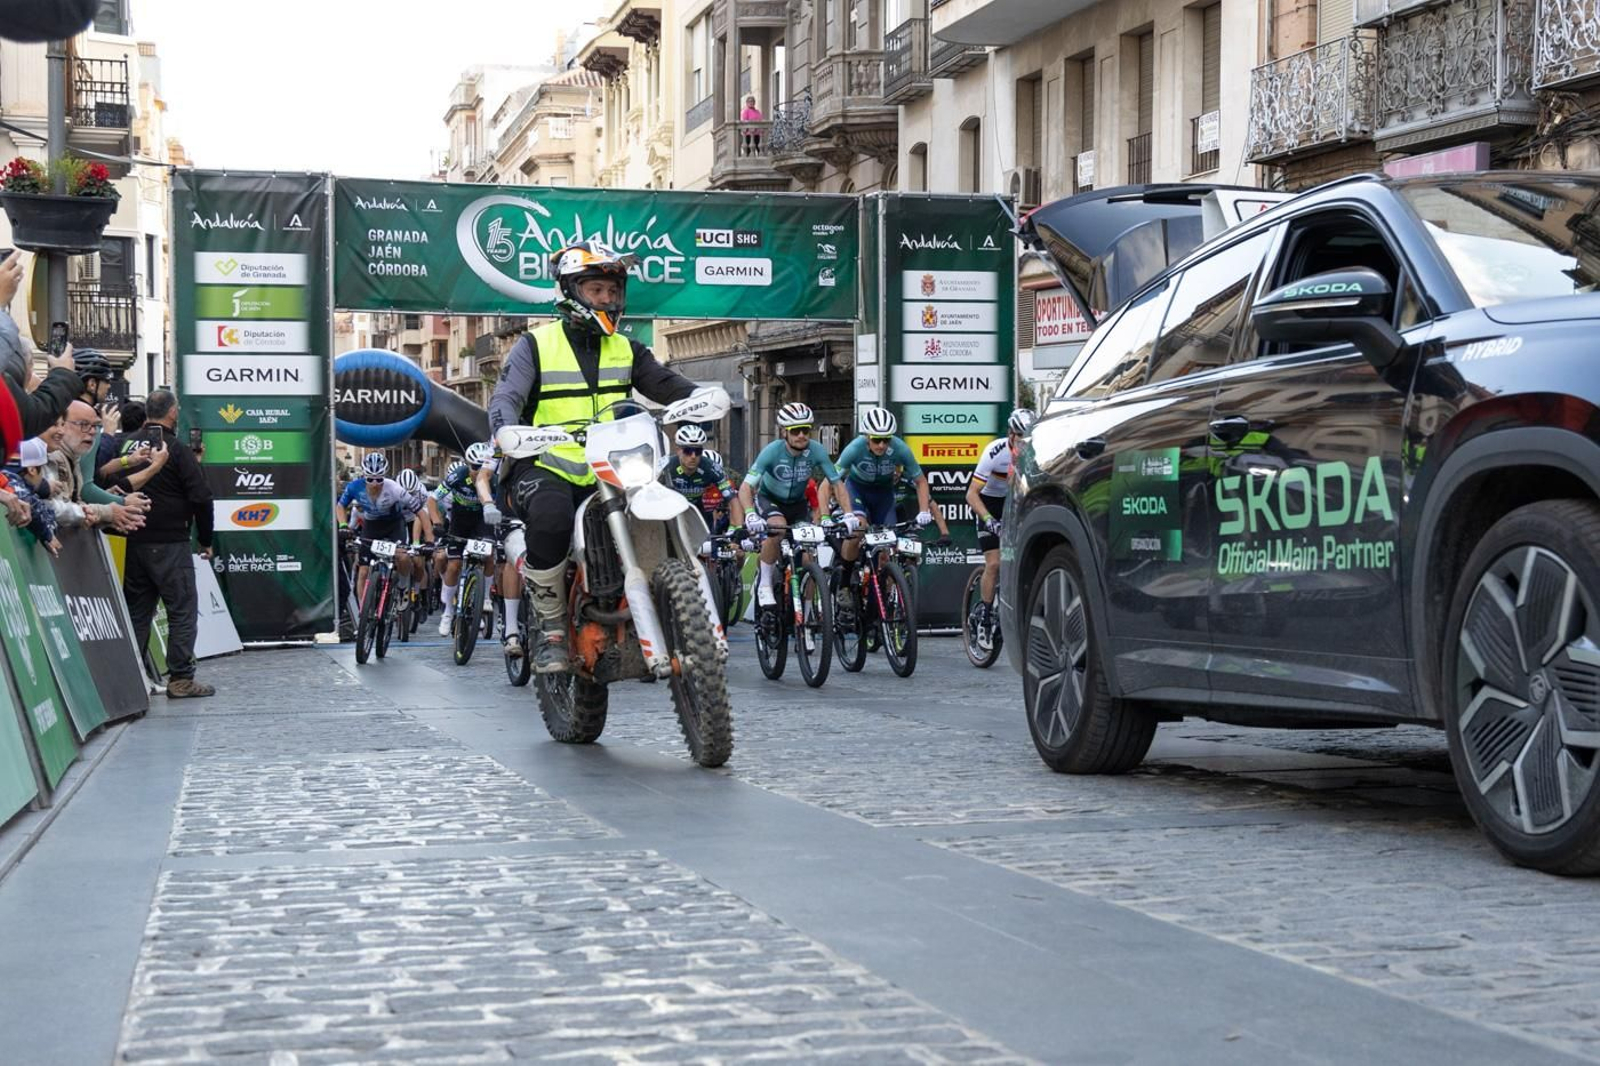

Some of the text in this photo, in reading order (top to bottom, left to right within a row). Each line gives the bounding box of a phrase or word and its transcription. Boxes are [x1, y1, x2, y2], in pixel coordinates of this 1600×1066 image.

[355, 196, 408, 211] Andalucía
[190, 211, 265, 231] Andalucía
[812, 224, 844, 235] octagon
[368, 229, 429, 244] GRANADA
[702, 232, 758, 244] UCI SHC
[900, 233, 962, 250] Andalucía
[368, 243, 402, 259] JAÉN
[241, 264, 284, 273] Diputación
[368, 262, 429, 276] CÓRDOBA
[704, 265, 764, 277] GARMIN
[244, 330, 285, 338] Diputación
[1037, 324, 1059, 337] TODO
[1062, 322, 1073, 334] EN
[1461, 336, 1524, 361] HYBRID
[206, 367, 299, 382] GARMIN
[910, 377, 990, 390] GARMIN
[668, 401, 709, 421] ACERBIS
[259, 416, 278, 424] JAÉN
[922, 443, 978, 457] PIRELLI
[235, 474, 275, 487] NDL
[237, 508, 271, 522] KH-7
[800, 528, 816, 539] 3-1
[872, 533, 889, 541] 3-2
[376, 541, 392, 553] 15-1
[473, 541, 487, 553] 8-2
[904, 541, 915, 551] 2-1
[926, 546, 966, 559] Andalucía
[229, 553, 275, 566] Andalucía
[1218, 535, 1394, 575] Official Main Partner
[228, 564, 249, 572] BIKE
[250, 564, 275, 572] RACE
[65, 594, 123, 642] GARMIN
